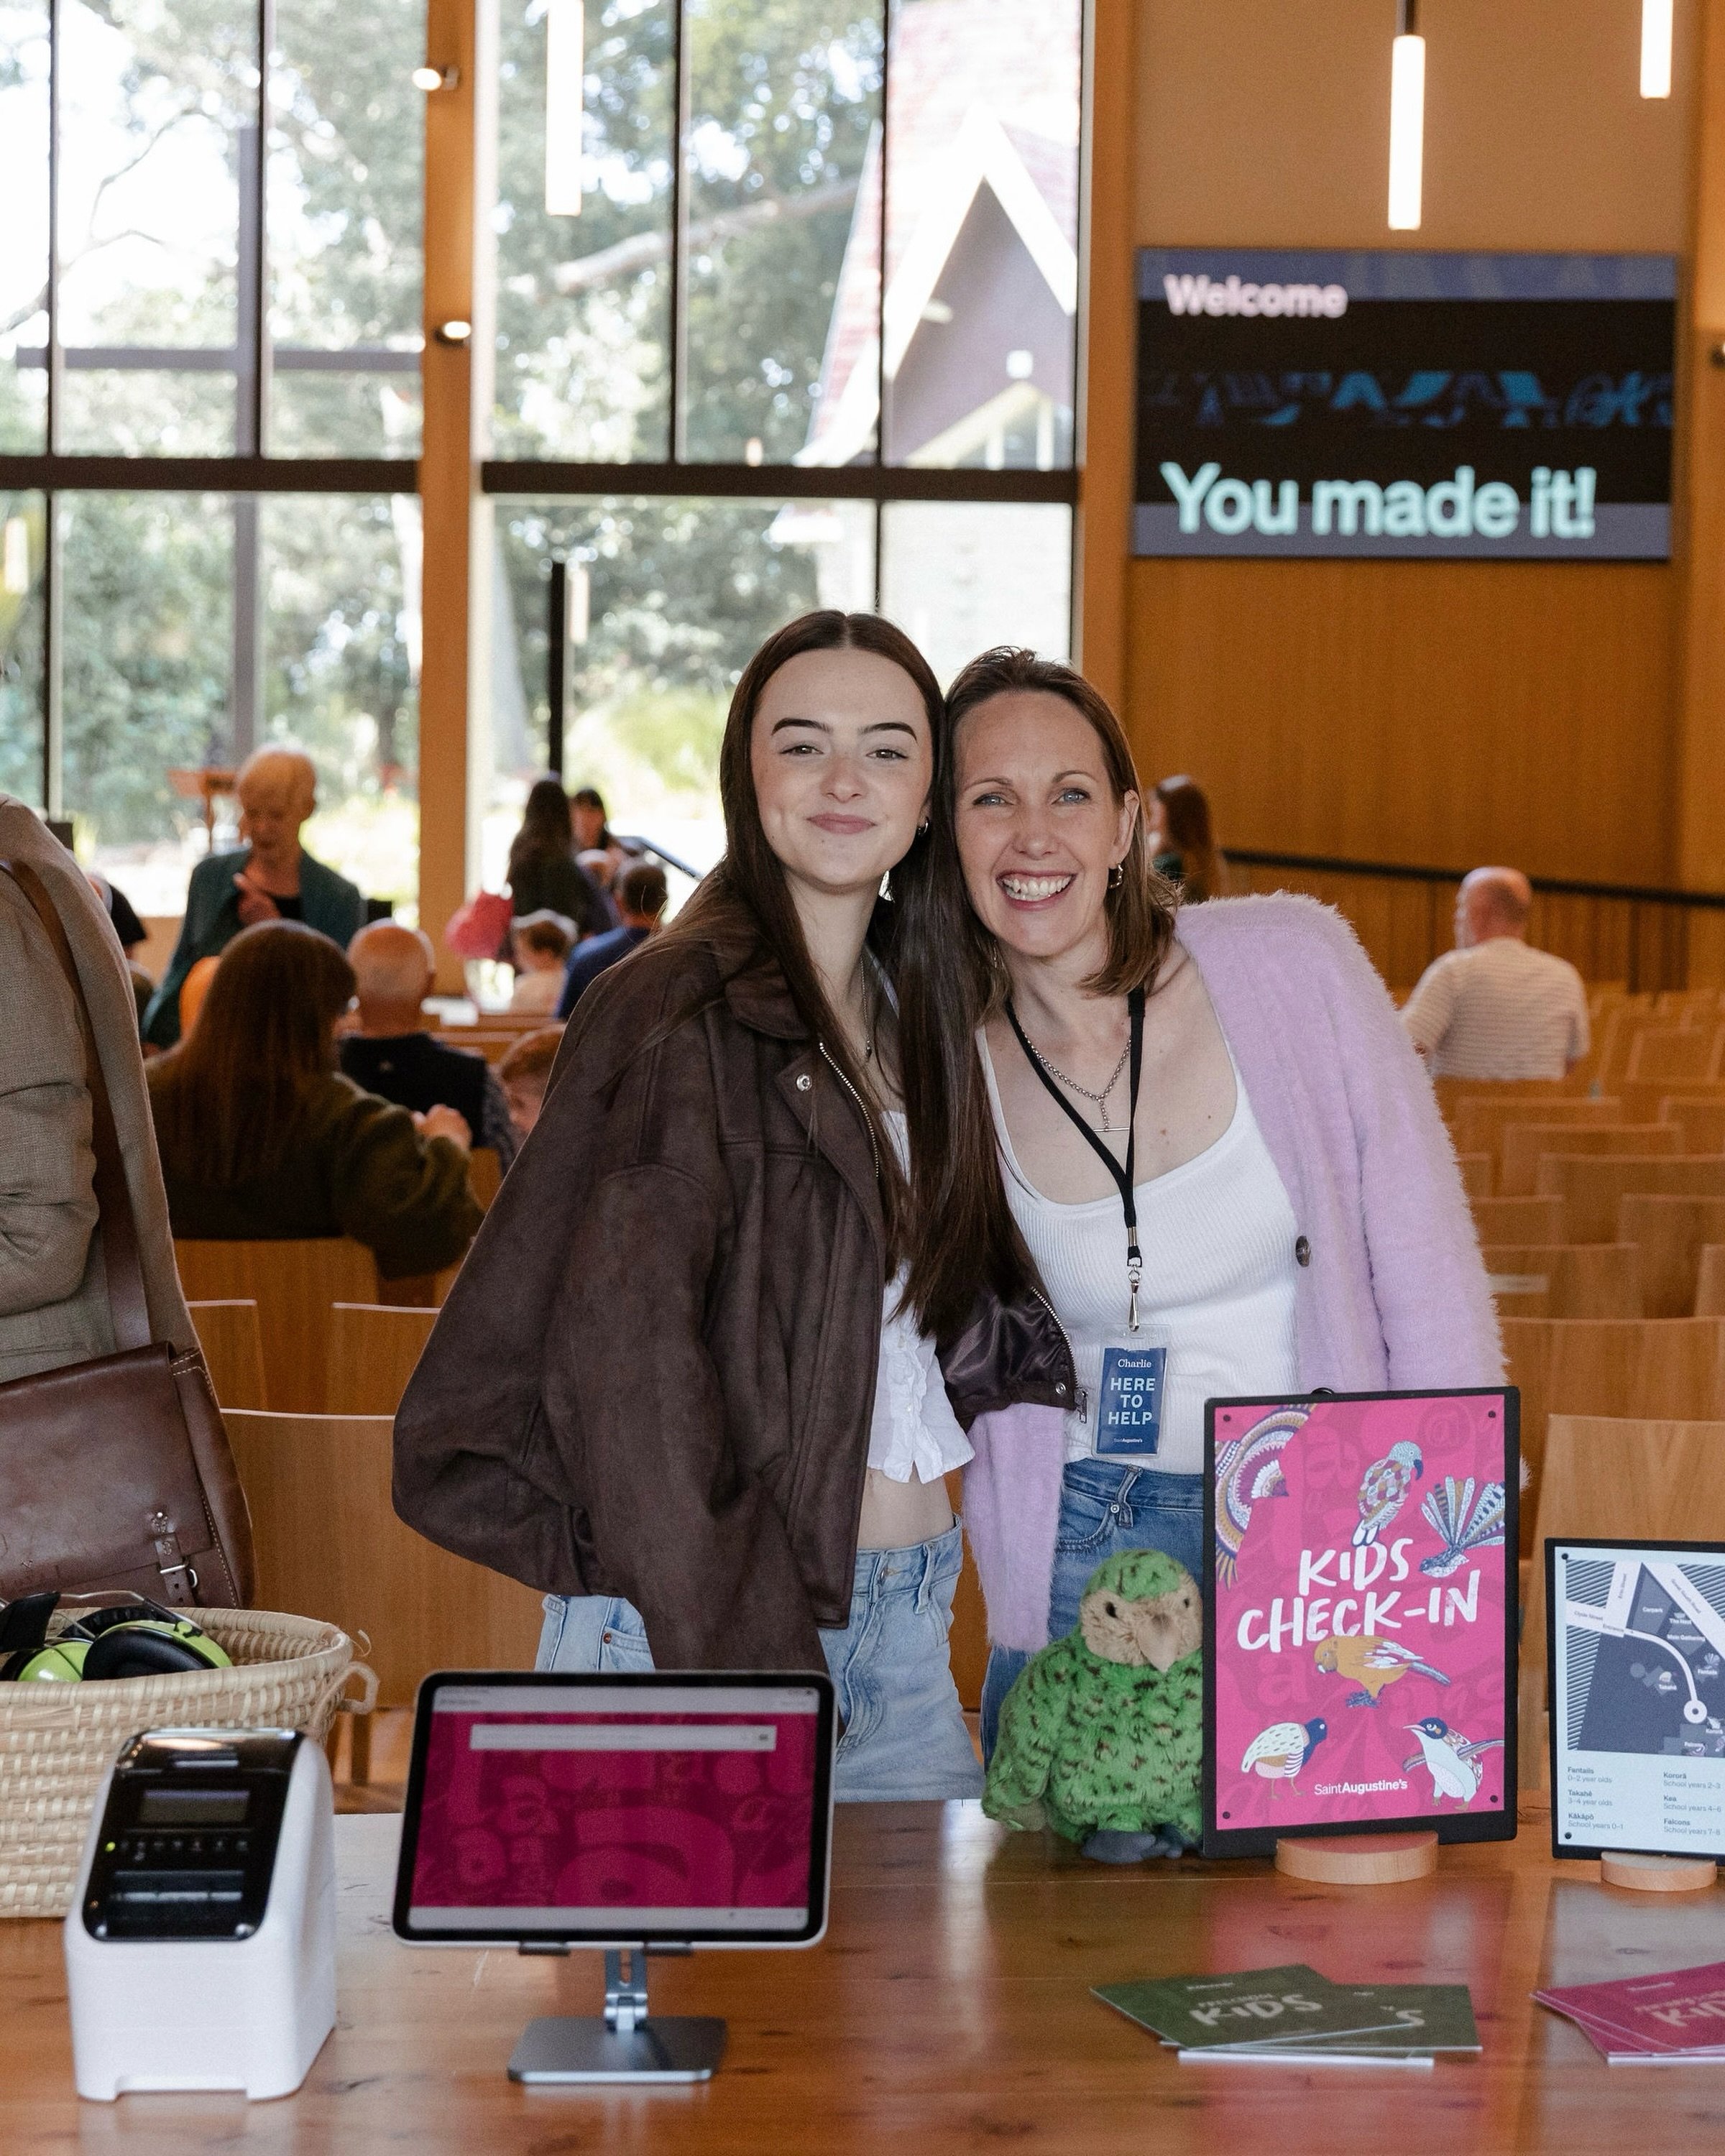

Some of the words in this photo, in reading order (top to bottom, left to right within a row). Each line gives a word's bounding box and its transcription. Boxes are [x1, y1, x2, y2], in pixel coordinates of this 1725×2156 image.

[1163, 275, 1349, 318] Welcome
[1159, 460, 1300, 536] You
[1312, 464, 1521, 538] made
[1530, 466, 1597, 540] it!
[1118, 1358, 1152, 1368] Charlie
[1110, 1377, 1156, 1391] HERE
[1120, 1394, 1144, 1409] TO
[1108, 1411, 1153, 1425] HELP
[1298, 1537, 1414, 1596] KIDS
[1236, 1569, 1481, 1653] CHECK-IN
[1314, 1779, 1408, 1795] SaintAugustine's
[1190, 1993, 1323, 2026] KIDS
